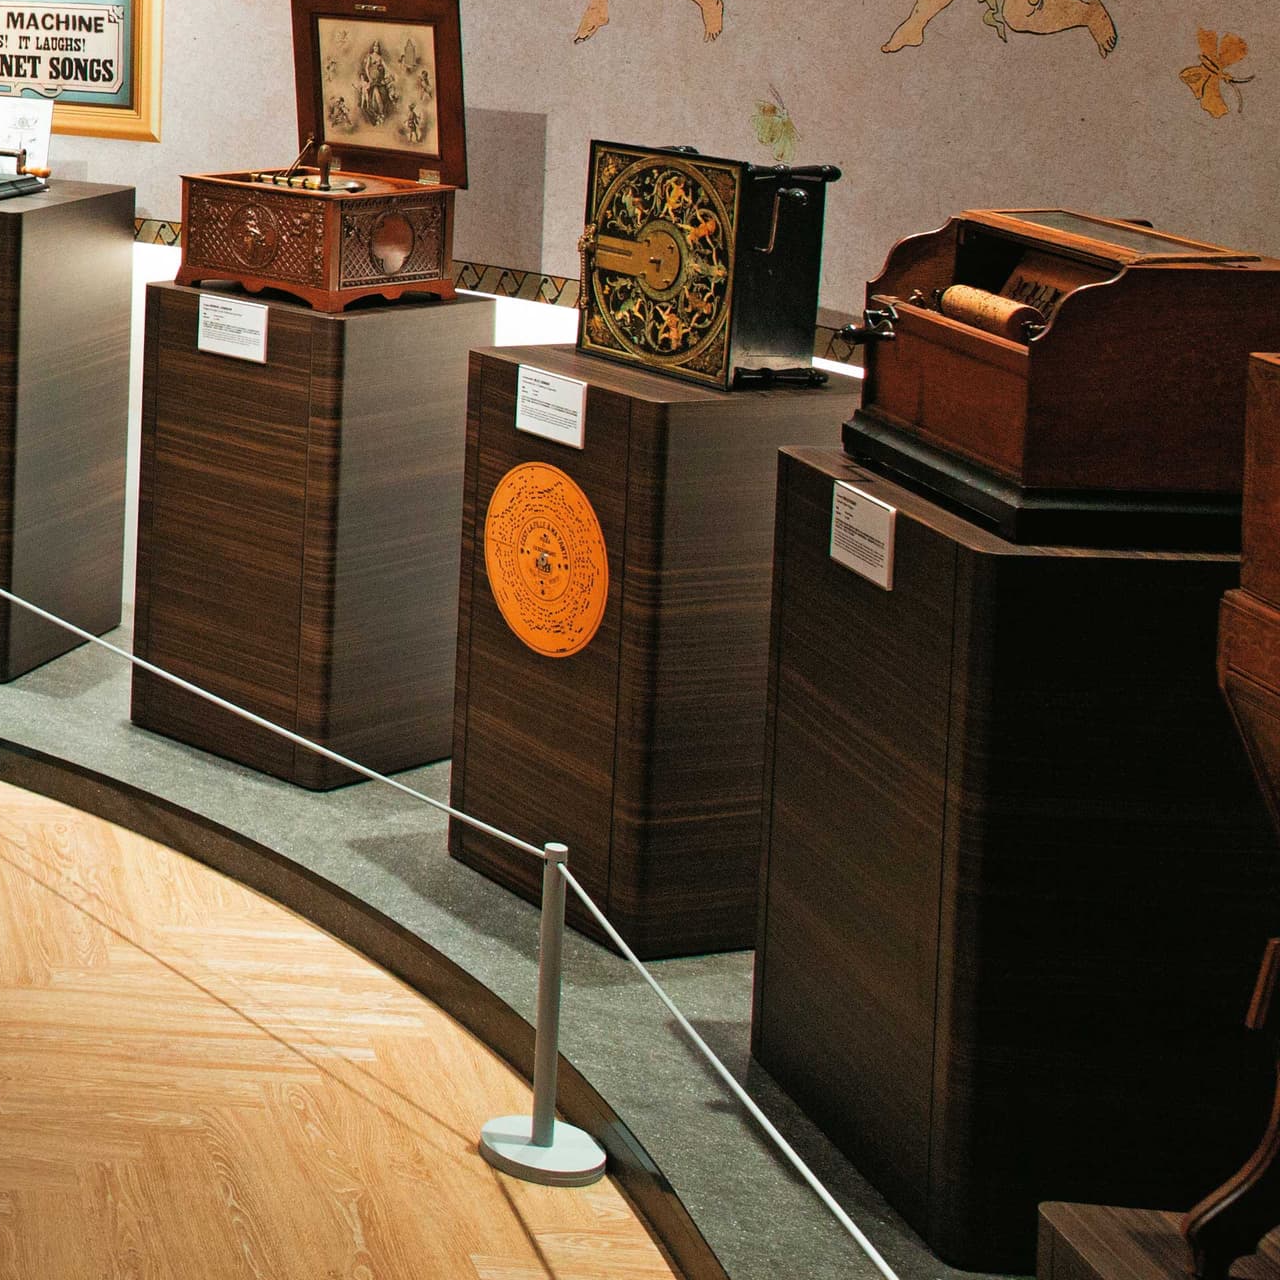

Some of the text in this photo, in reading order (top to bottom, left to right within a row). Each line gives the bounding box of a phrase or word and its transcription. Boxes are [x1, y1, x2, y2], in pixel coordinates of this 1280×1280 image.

[6, 11, 105, 33] MACHINE
[18, 35, 31, 50] IT
[35, 36, 86, 52] LAUGHS!
[49, 56, 114, 82] SONGS
